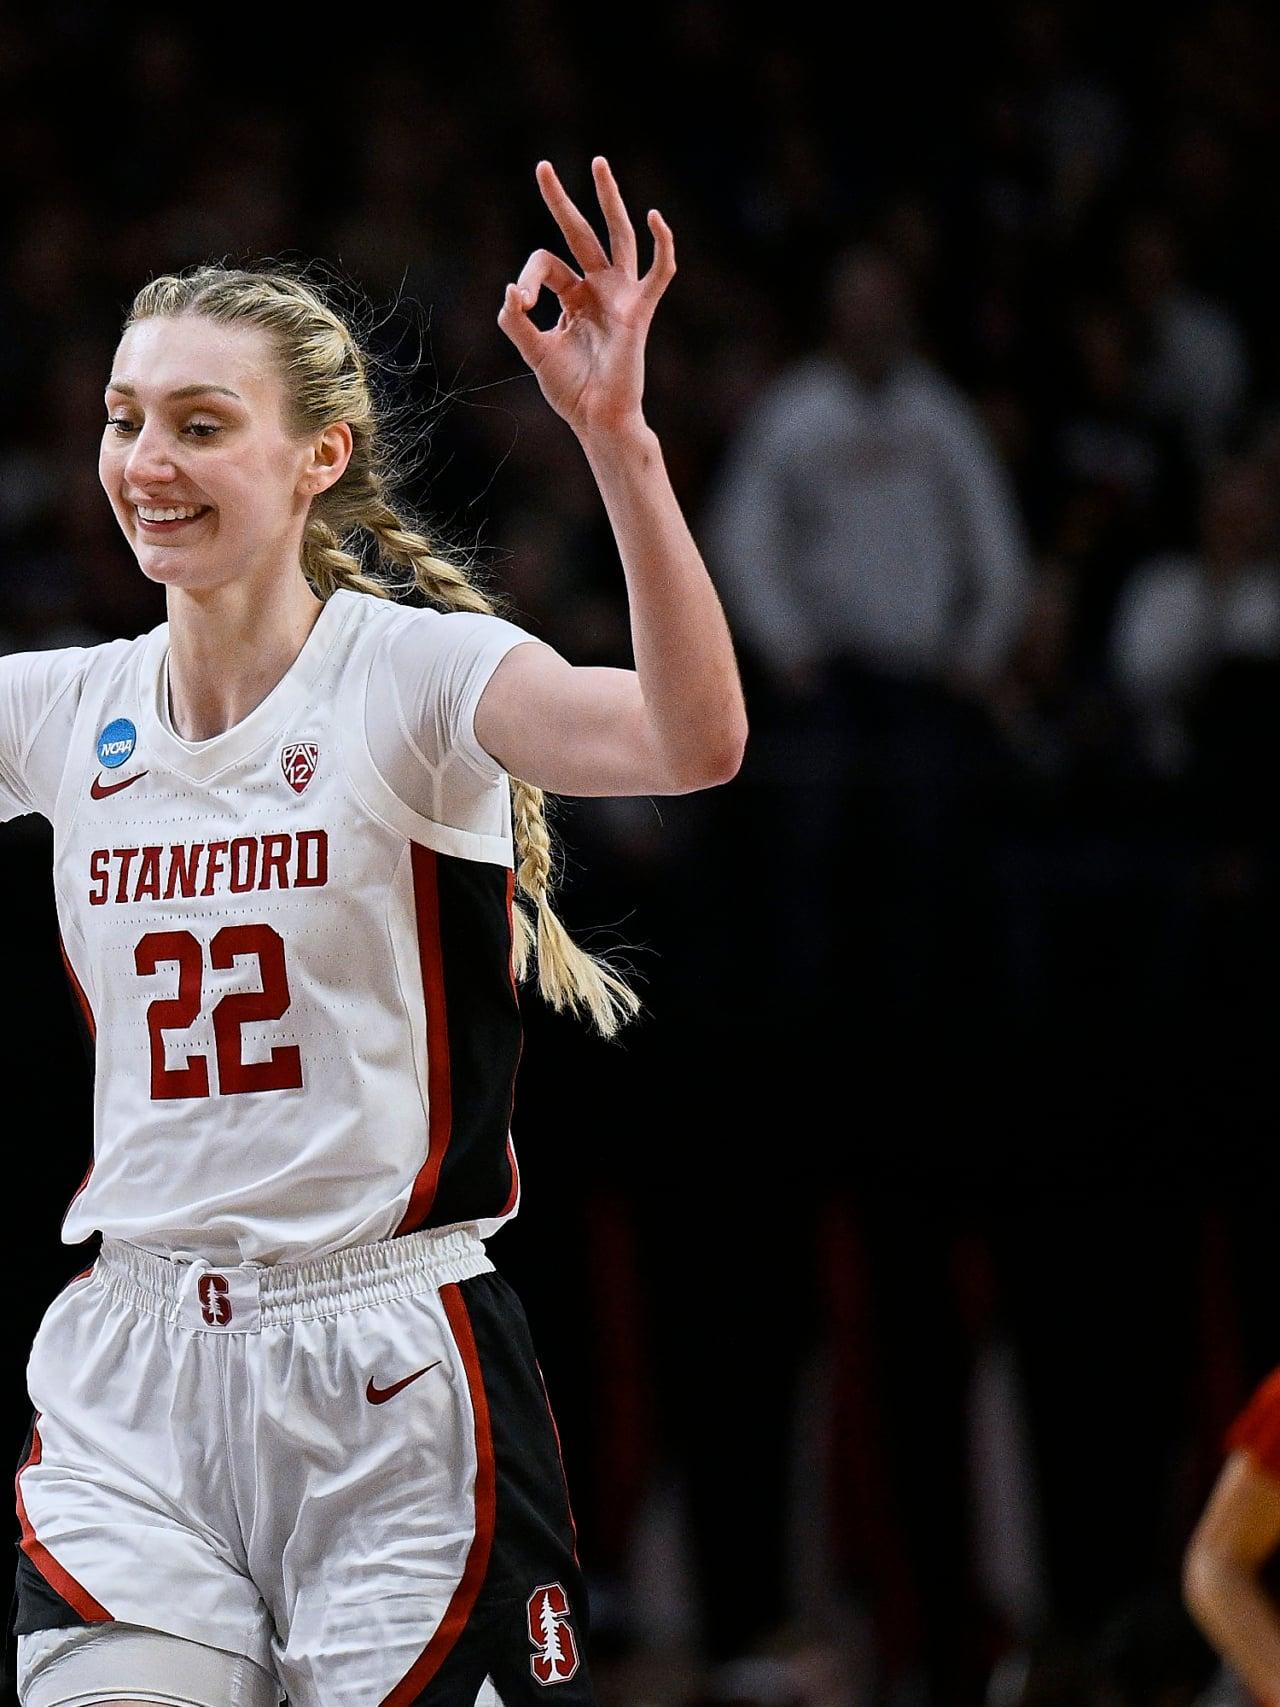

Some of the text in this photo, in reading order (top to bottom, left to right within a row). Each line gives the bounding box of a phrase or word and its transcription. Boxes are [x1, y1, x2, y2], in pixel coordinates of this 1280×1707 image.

[101, 739, 132, 757] NCAA
[282, 744, 318, 775] PAC
[290, 764, 309, 784] 12
[89, 829, 328, 905] STANFORD
[134, 923, 303, 1100] 22
